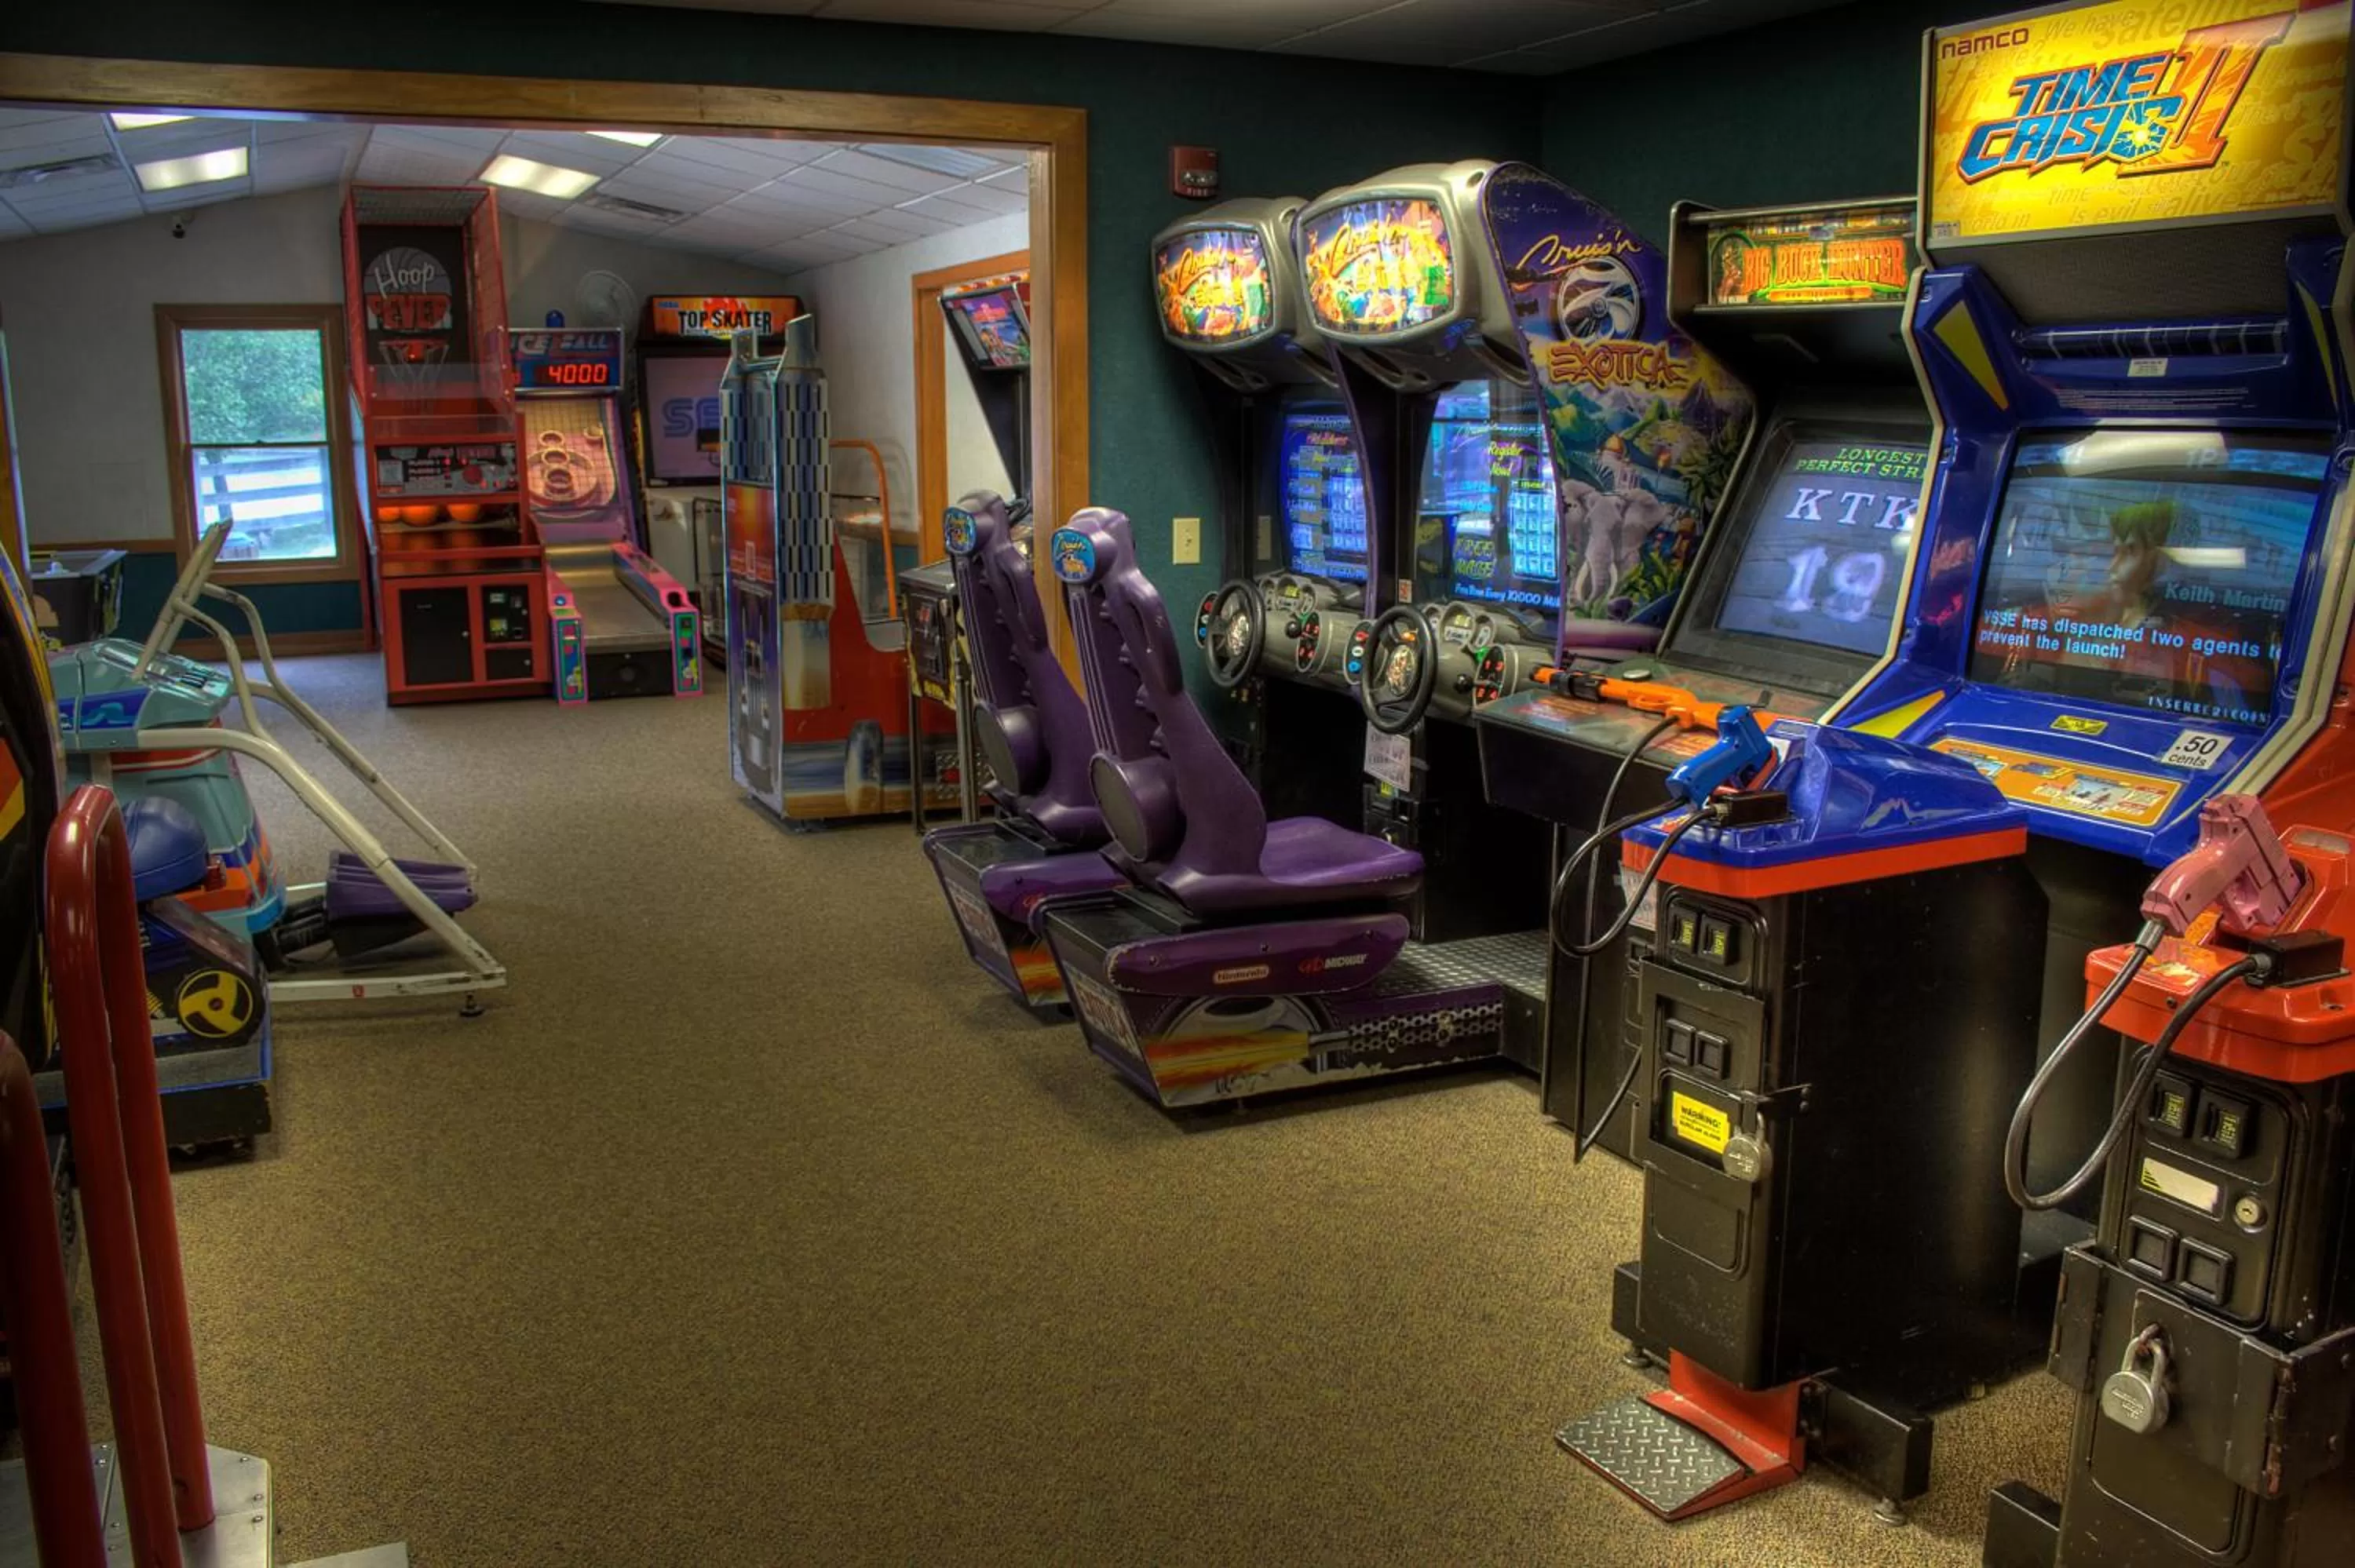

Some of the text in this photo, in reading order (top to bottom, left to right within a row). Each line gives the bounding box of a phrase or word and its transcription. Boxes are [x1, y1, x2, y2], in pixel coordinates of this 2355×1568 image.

[1941, 27, 2029, 60] namco
[2009, 52, 2174, 118] TIME
[1958, 96, 2186, 186] CRISIS
[1517, 230, 1642, 270] Cruis'n
[374, 253, 435, 300] Hoop
[1743, 238, 1906, 295] BIG BUCK HUNTER
[678, 310, 772, 334] TOP SKATER
[549, 363, 608, 384] 4000
[1550, 341, 1689, 391] EXOTICA
[1795, 459, 1875, 476] PERFECT
[1836, 448, 1927, 465] LONGEST
[1773, 543, 1886, 622] 19
[2164, 580, 2286, 612] Keith Martin
[1979, 629, 2126, 659] prevent the launch!
[1983, 608, 2017, 627] VSSE
[2021, 615, 2048, 631] has
[2054, 617, 2144, 643] dispatched
[2151, 629, 2185, 648] two
[2192, 636, 2261, 657] agents
[2168, 754, 2208, 768] cents
[2174, 735, 2218, 756] .50
[1324, 946, 1368, 969] MIDWAY
[1217, 966, 1269, 981] Nintendo
[1681, 1105, 1722, 1128] WARNING:
